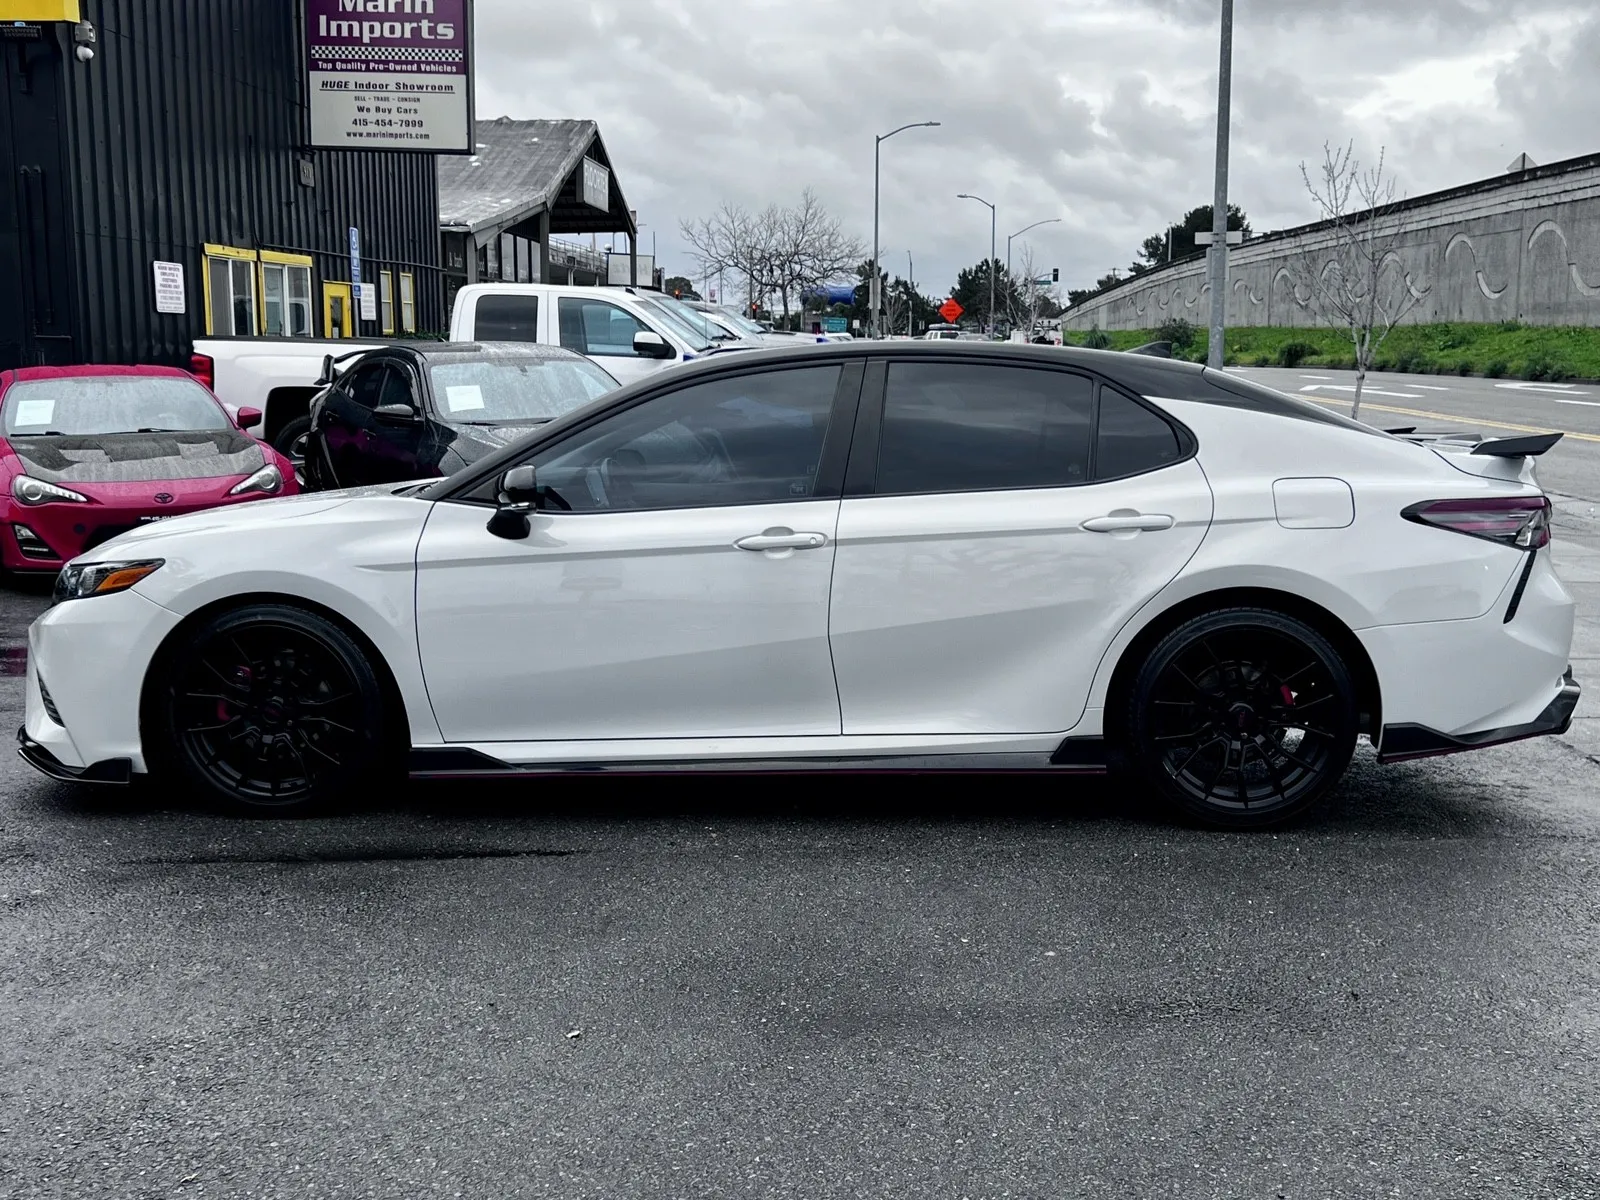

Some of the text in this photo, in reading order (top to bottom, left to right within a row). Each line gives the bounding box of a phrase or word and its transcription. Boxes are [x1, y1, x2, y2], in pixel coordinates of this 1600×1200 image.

[338, 0, 434, 14] Marin
[319, 14, 455, 44] Imports
[318, 61, 457, 72] Top Quality Pre-Owned Vehicles
[321, 80, 454, 92] HUGE Indoor Showroom
[356, 105, 418, 115] We Buy Cars
[346, 131, 430, 140] www.marinimports.com
